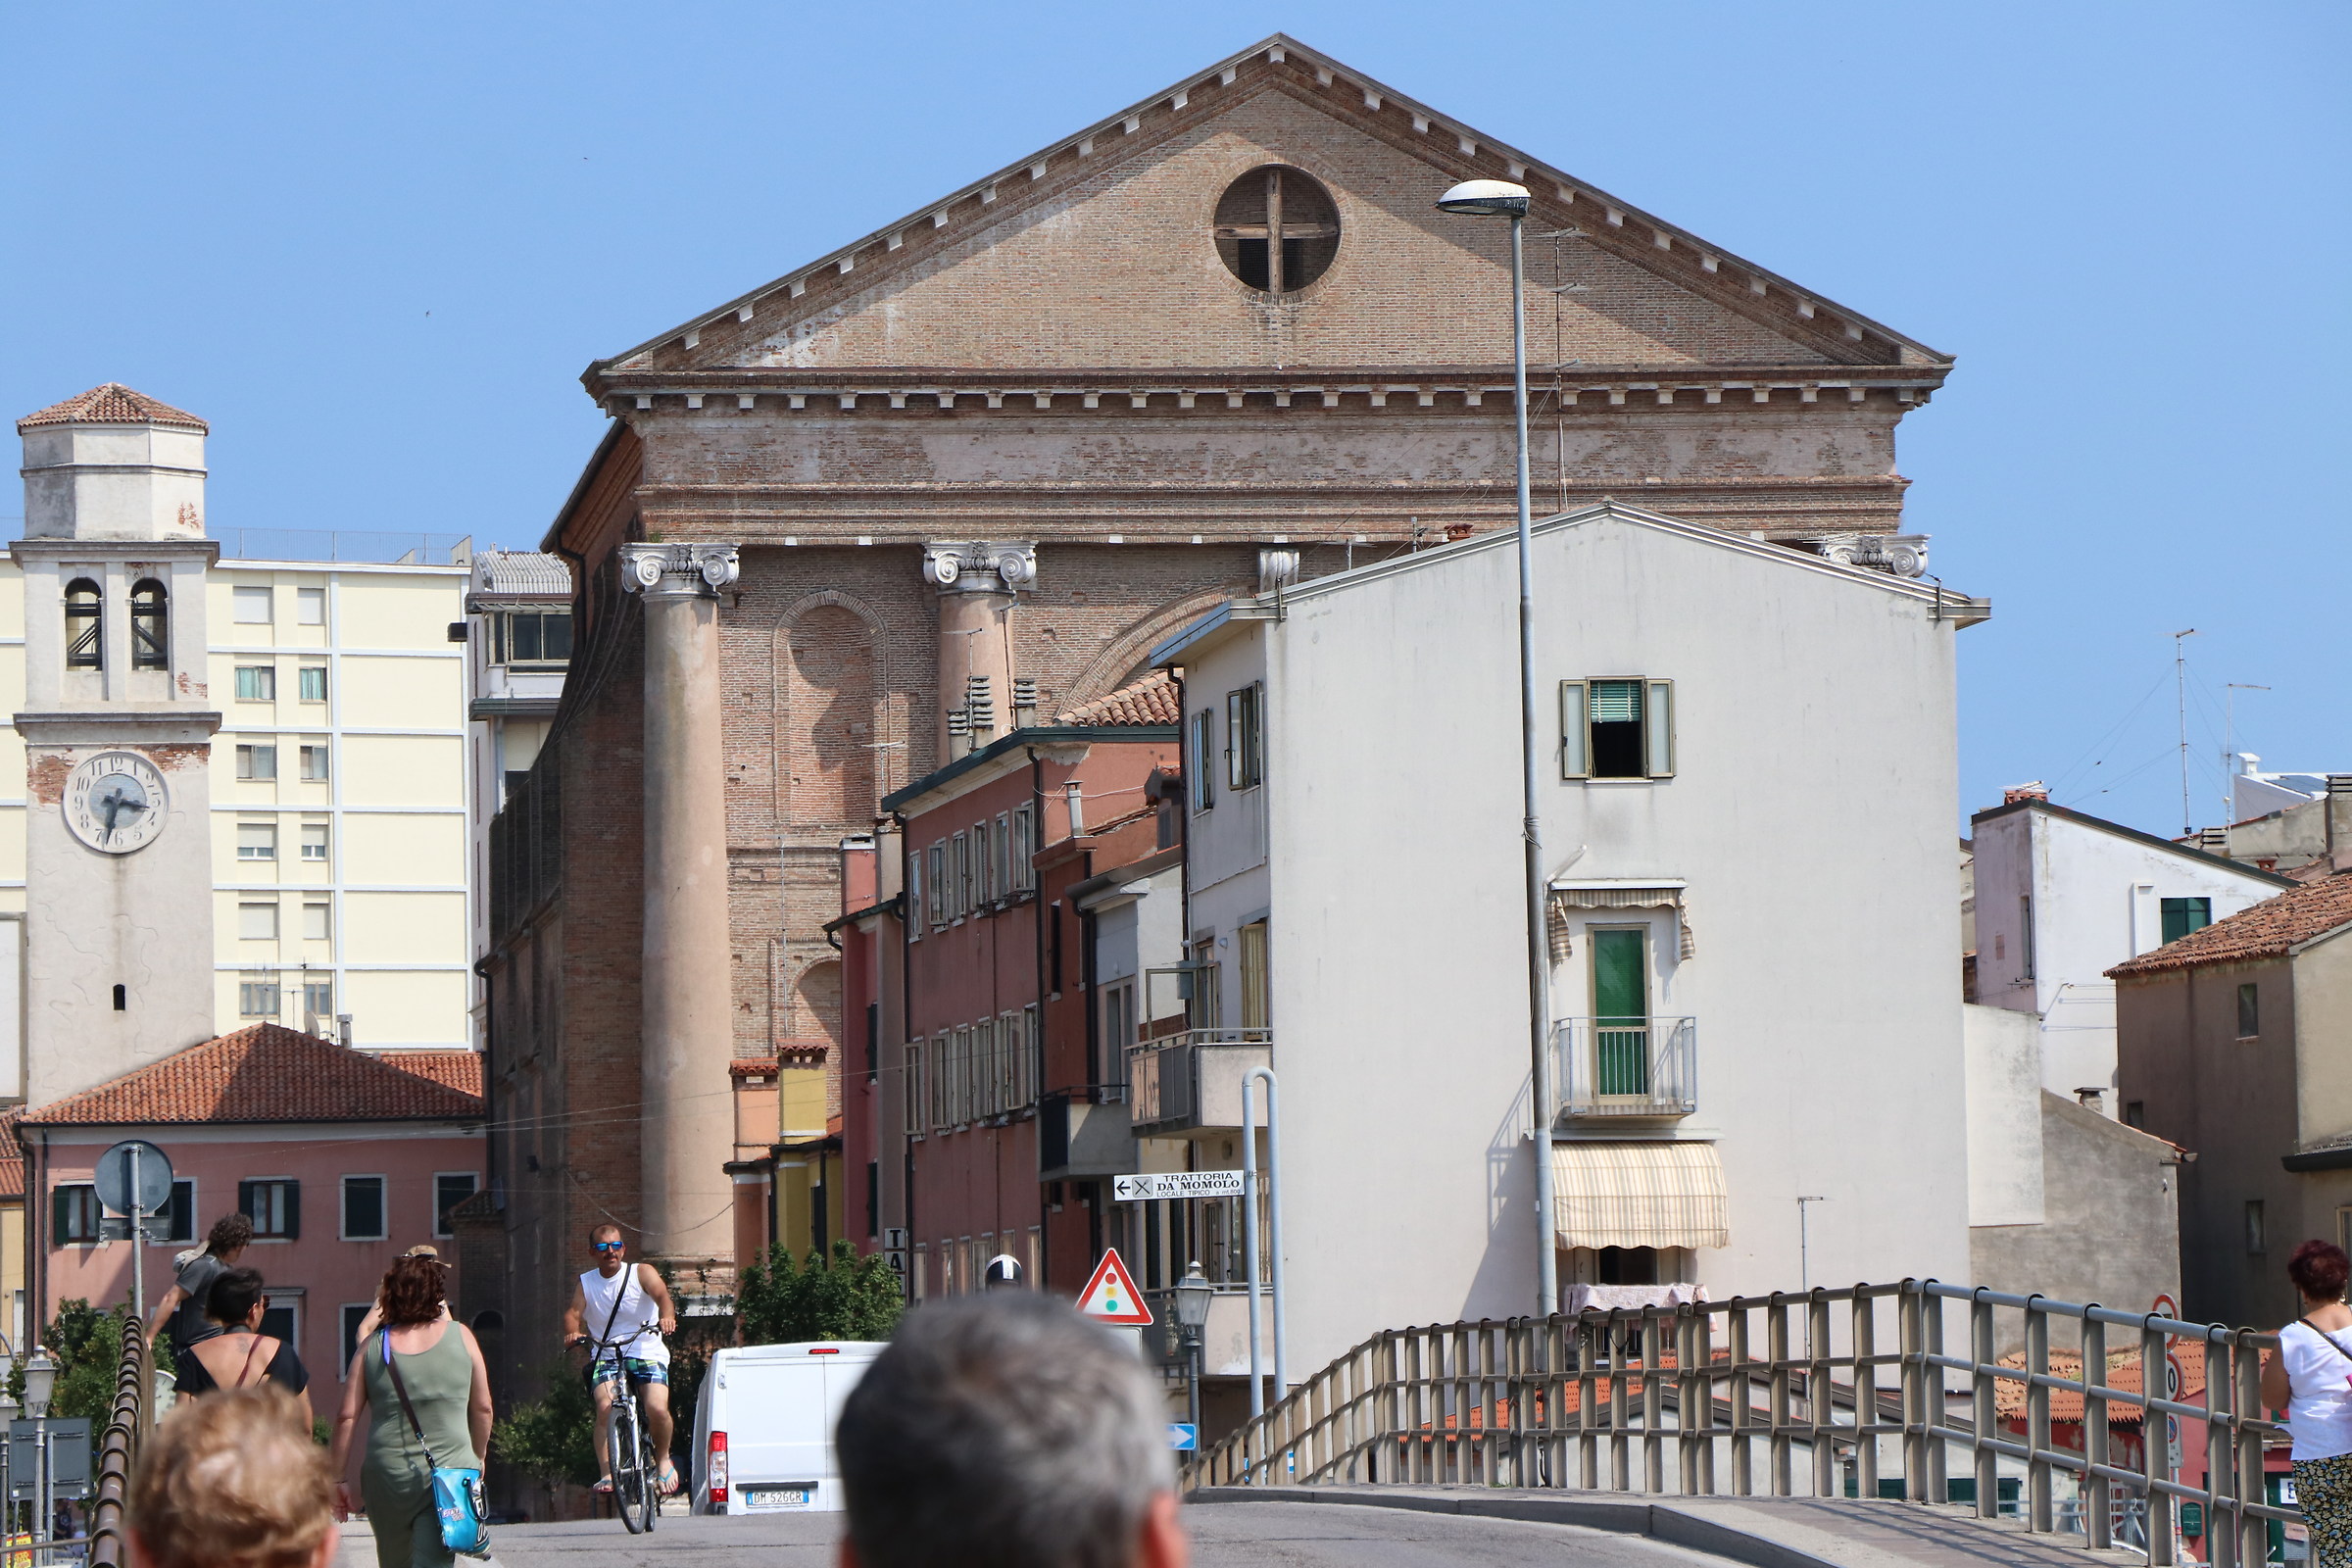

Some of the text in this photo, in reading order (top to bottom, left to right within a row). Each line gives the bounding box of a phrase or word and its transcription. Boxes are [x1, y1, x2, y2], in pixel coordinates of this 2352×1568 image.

[91, 760, 102, 776] 11
[110, 757, 123, 772] 12
[133, 760, 137, 776] 1
[76, 776, 90, 792] 10
[145, 772, 155, 788] 2
[74, 795, 83, 810] 9
[80, 813, 89, 829] 8
[95, 828, 103, 843] 7
[115, 831, 123, 846] 6
[133, 824, 142, 840] 5
[1163, 1172, 1233, 1183] TRATTORIA
[1156, 1179, 1240, 1192] DA MOMOLO
